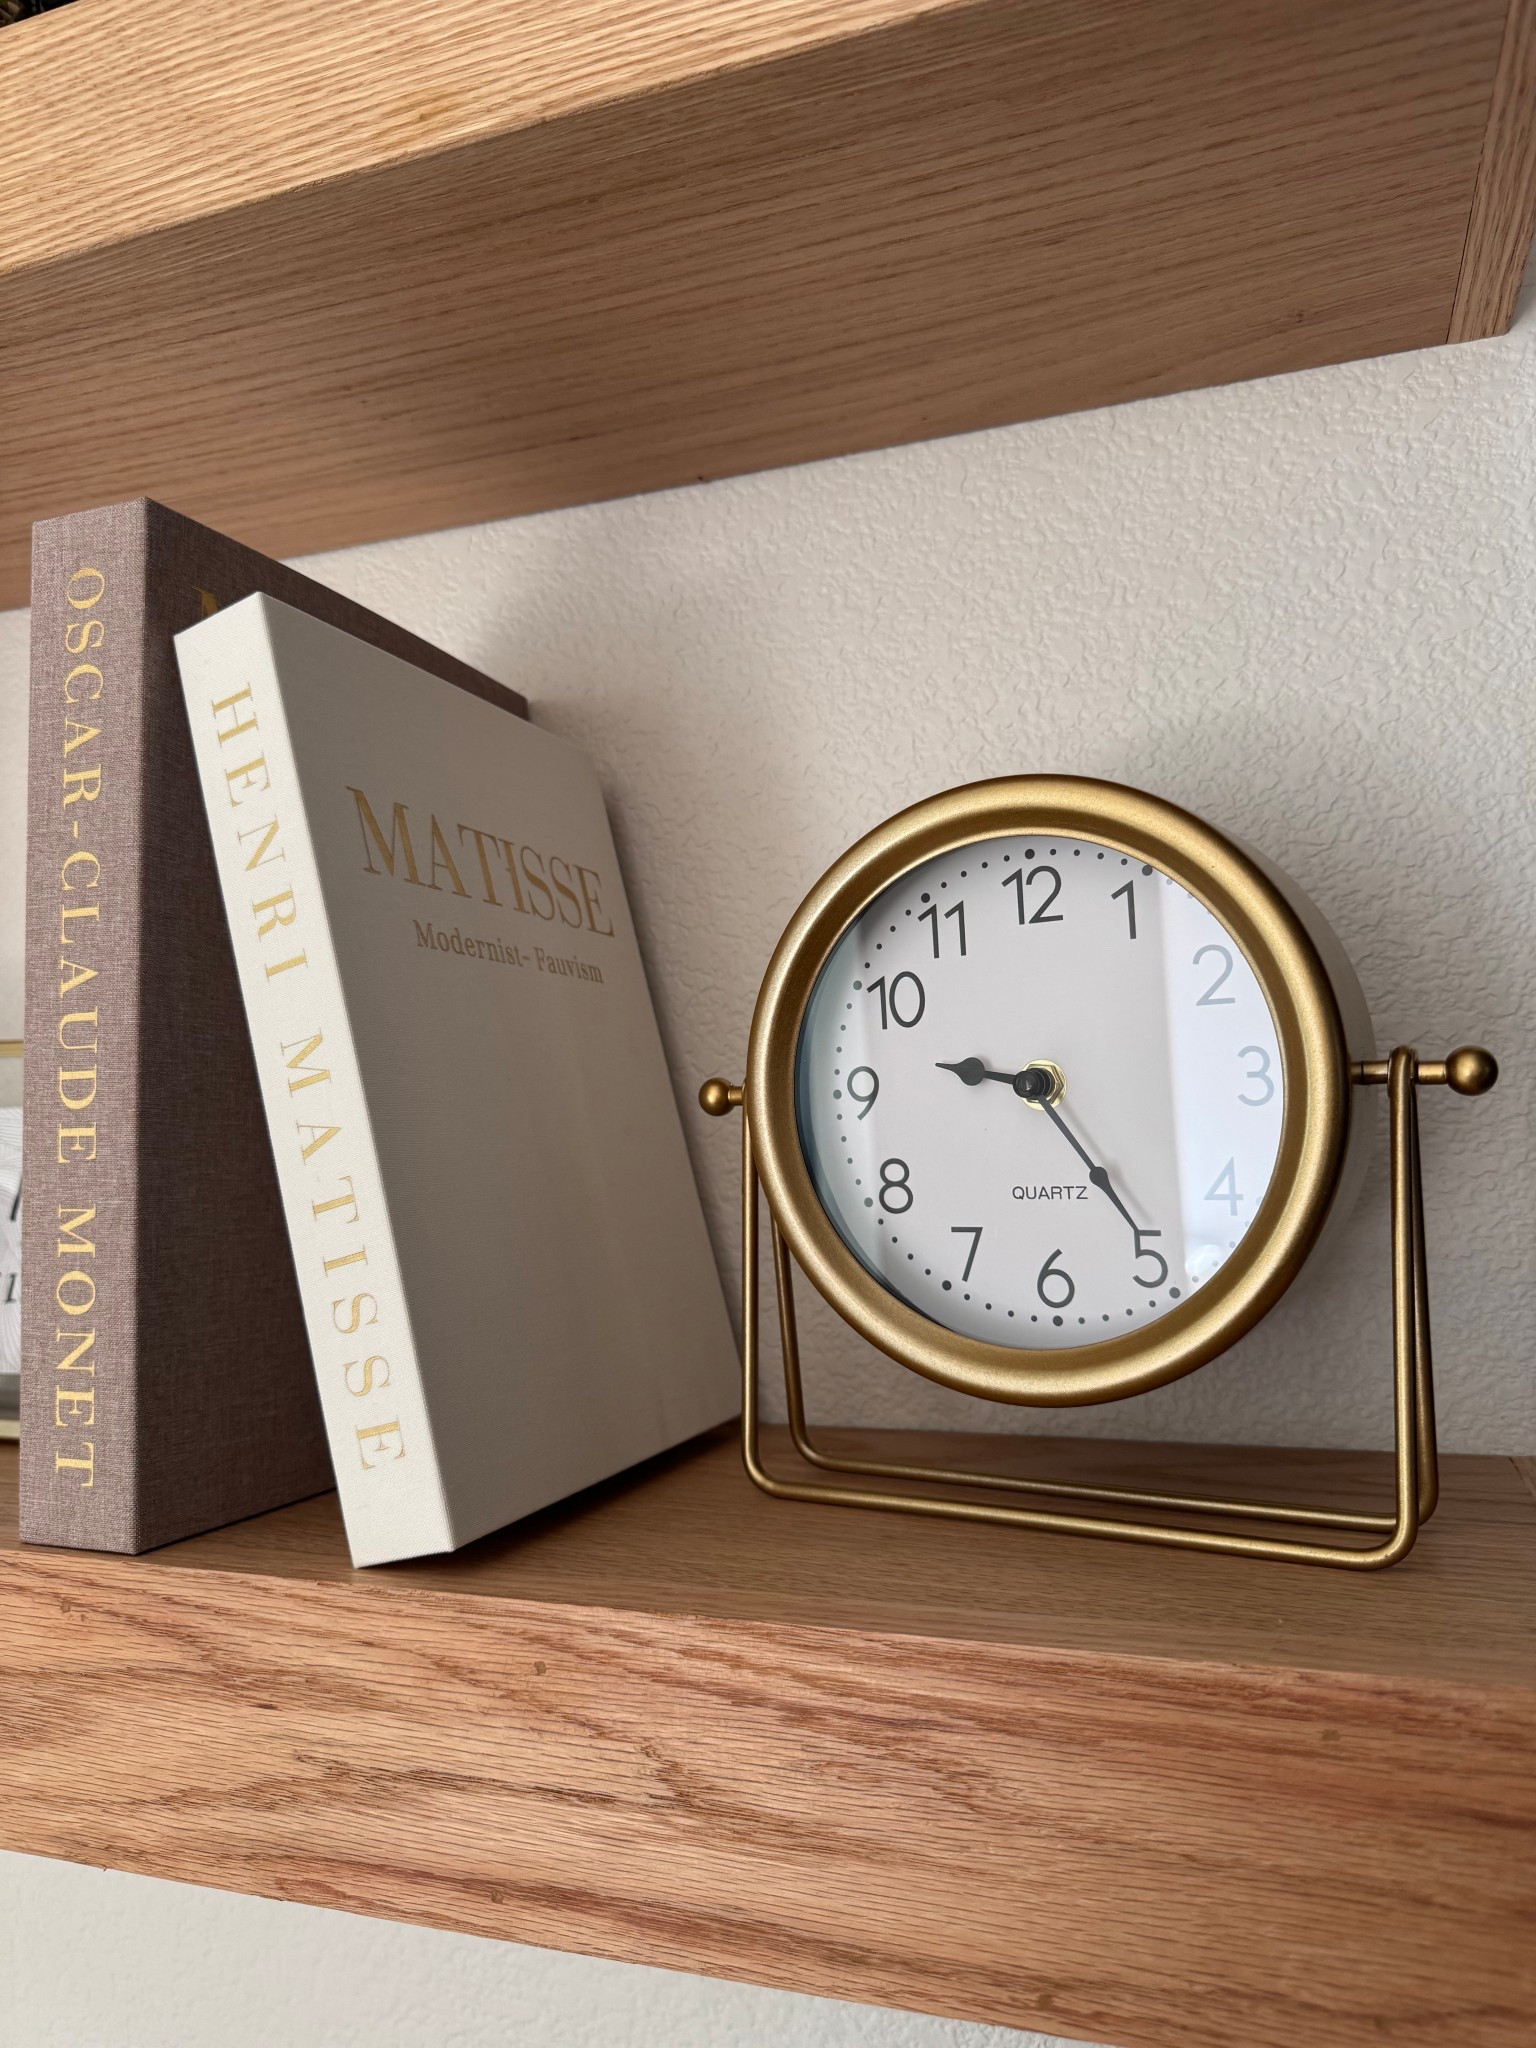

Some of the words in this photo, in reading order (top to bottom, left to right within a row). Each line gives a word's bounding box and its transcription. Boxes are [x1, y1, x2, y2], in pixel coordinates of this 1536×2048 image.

[57, 566, 106, 1164] OSCAR-CLAUDE
[346, 785, 616, 938] MATISSE
[1001, 865, 1064, 925] 12
[1111, 879, 1138, 940] 1
[917, 900, 967, 959] 11
[533, 946, 605, 984] Fauvism
[1191, 944, 1236, 1007] 2
[866, 970, 926, 1030] 10
[211, 681, 310, 982] HENRI
[279, 1027, 407, 1470] MATISSE
[846, 1065, 880, 1121] 9
[1235, 1045, 1276, 1107] 3
[878, 1157, 914, 1215] 8
[1011, 1185, 1089, 1201] QUARTZ
[1203, 1156, 1244, 1217] 4
[950, 1225, 984, 1283] 7
[1036, 1248, 1076, 1309] 6
[1132, 1228, 1169, 1289] 5
[55, 1207, 97, 1488] MONET
